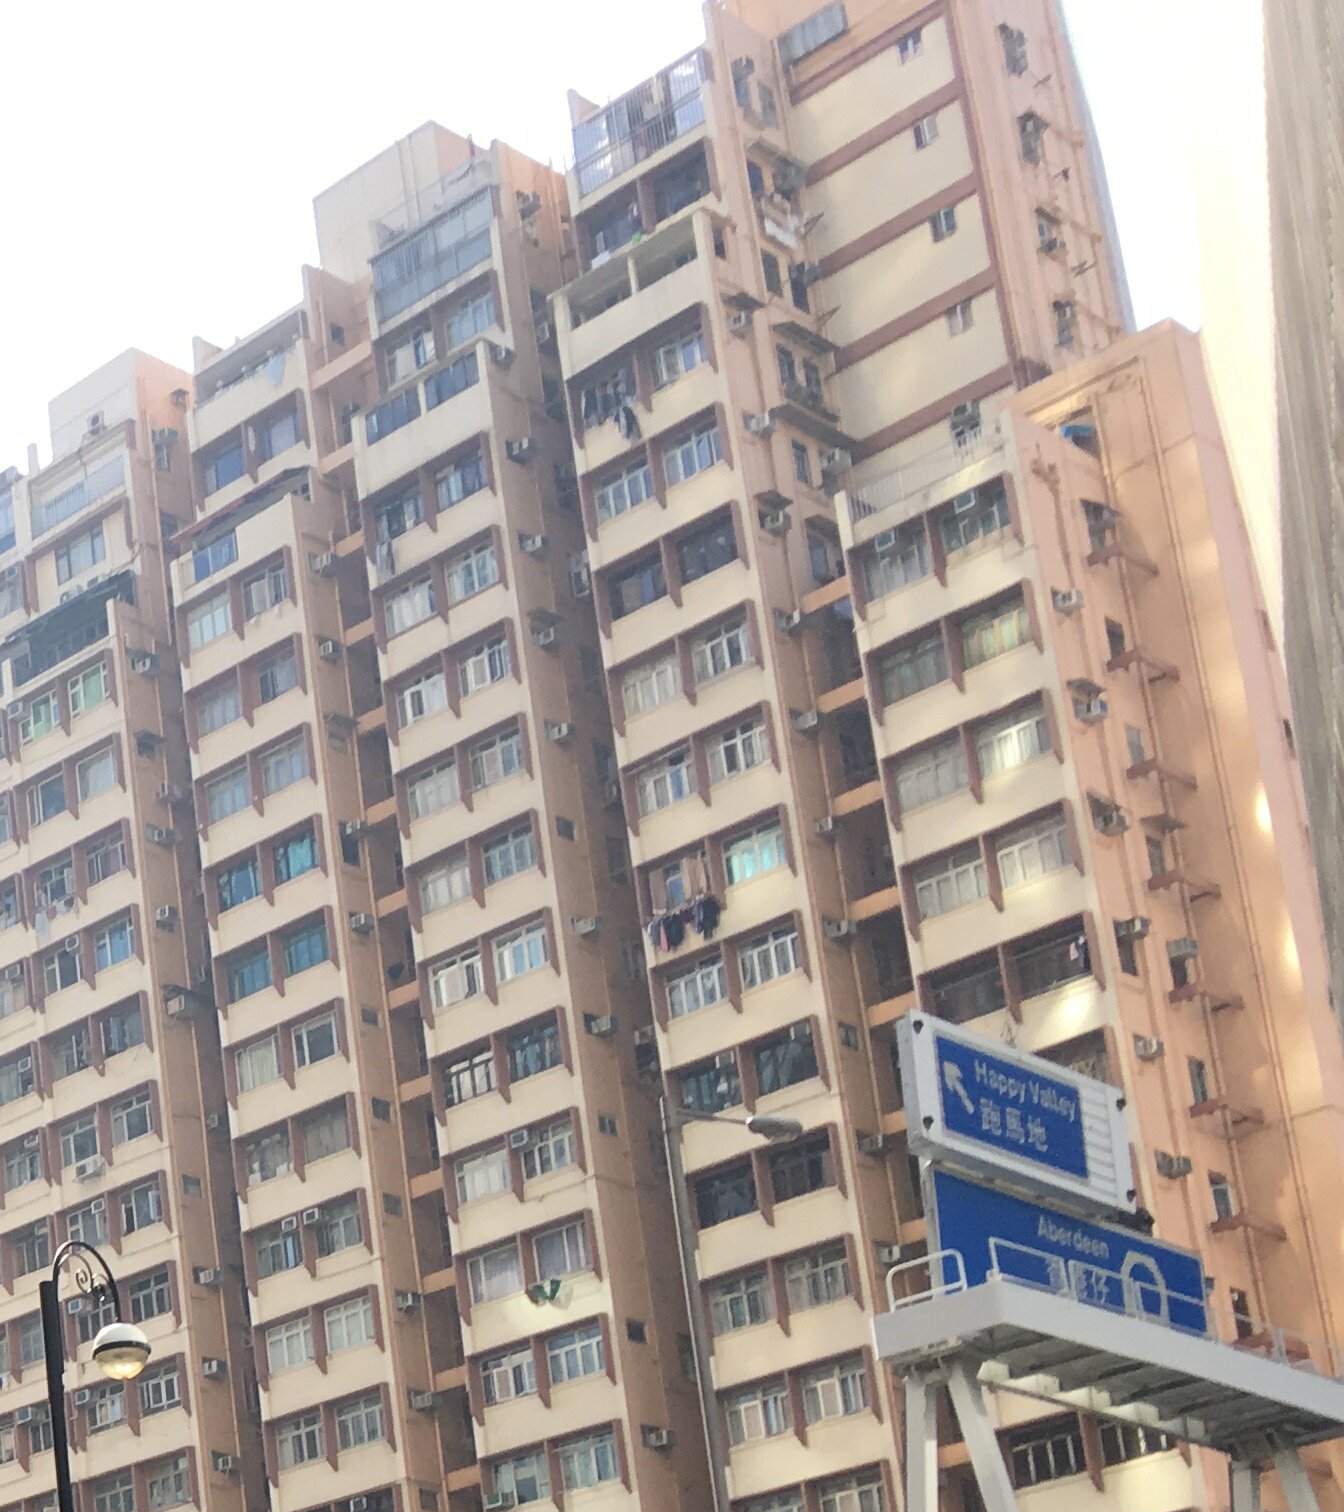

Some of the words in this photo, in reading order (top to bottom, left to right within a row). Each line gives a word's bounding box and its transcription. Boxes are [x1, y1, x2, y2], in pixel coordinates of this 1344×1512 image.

[974, 1059, 1025, 1103] Happy
[1029, 1080, 1075, 1122] Valley
[980, 1098, 1049, 1152] 跑馬地
[1037, 1214, 1110, 1259] Aberdeen
